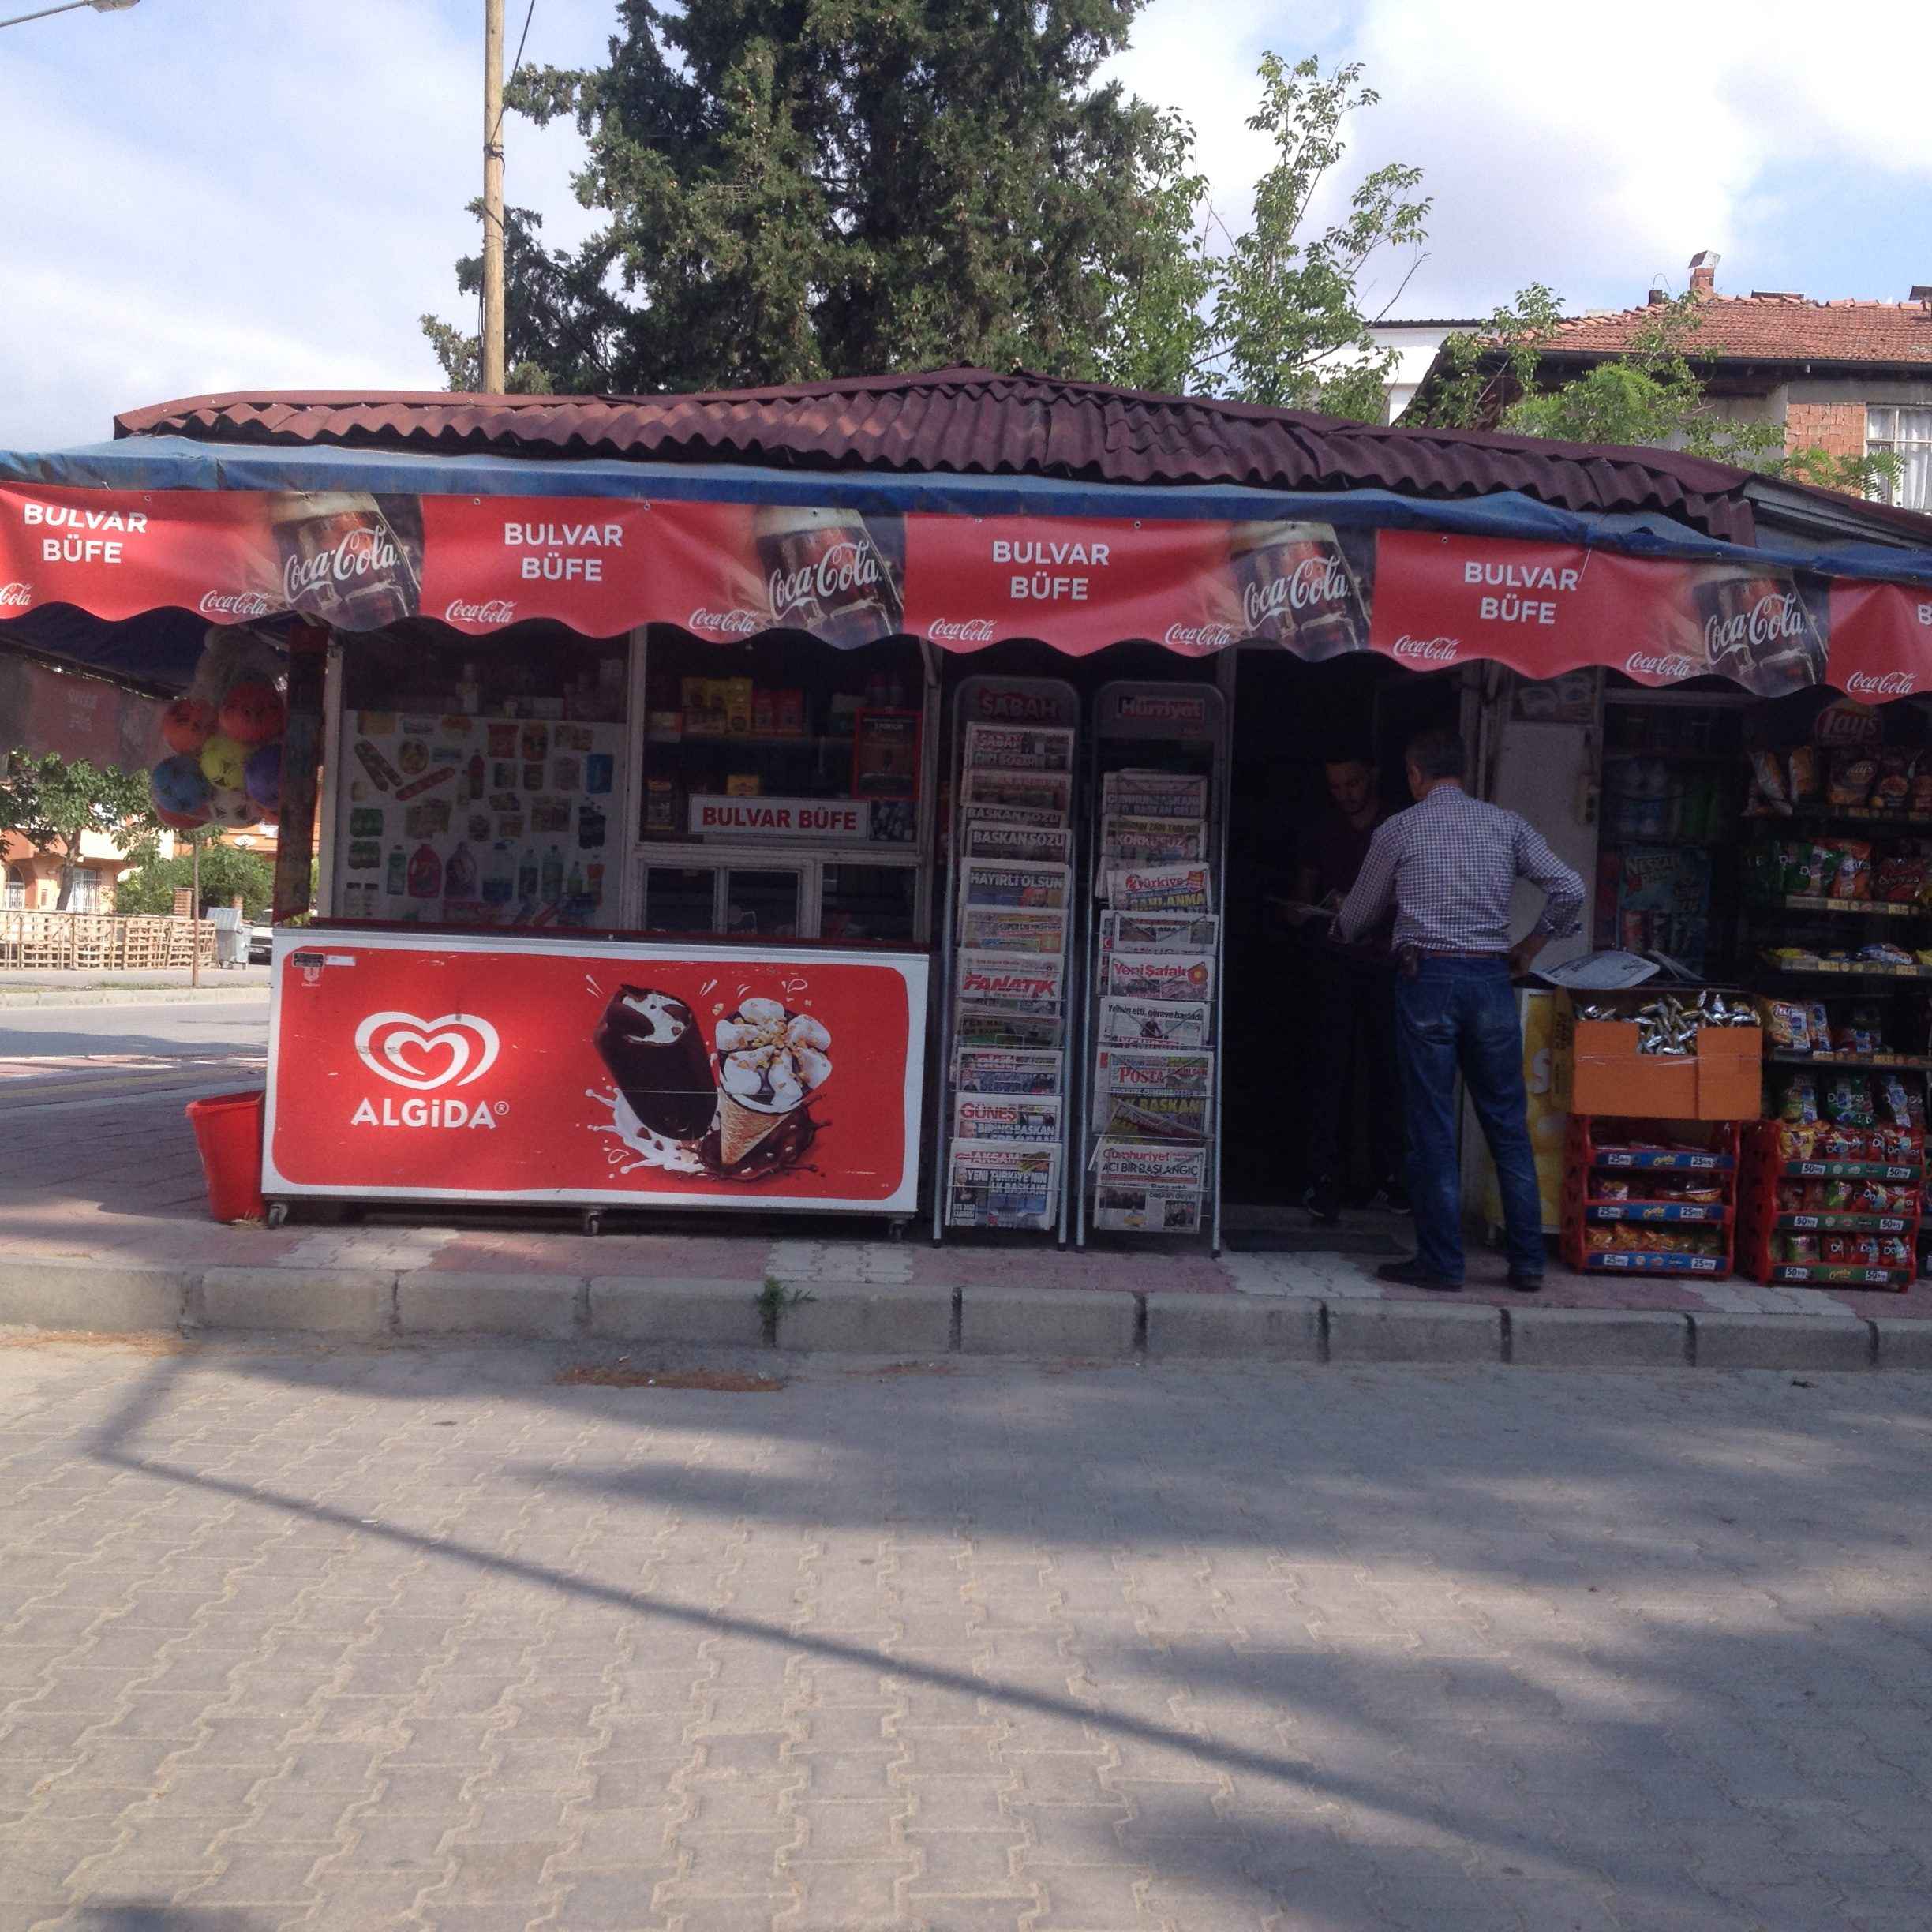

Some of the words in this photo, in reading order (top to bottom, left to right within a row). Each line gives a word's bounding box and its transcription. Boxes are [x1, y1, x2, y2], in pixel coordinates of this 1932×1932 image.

[24, 504, 148, 534] BULVAR
[504, 522, 623, 548] BULVAR
[43, 535, 124, 564] BÜFE
[993, 541, 1110, 567] BULVAR
[283, 524, 397, 603] Coca-Cola
[522, 552, 603, 582] BÜFE
[1465, 562, 1578, 591] BULVAR
[768, 540, 880, 620] Coca-Cola
[1010, 571, 1089, 601] BÜFE
[1243, 555, 1348, 630] Coca-Cola
[199, 590, 269, 616] Coca-Cola
[445, 599, 518, 624] Coca-Cola
[1480, 593, 1557, 625] BÜFE
[689, 608, 758, 634] Coca-Cola
[928, 619, 996, 642] Coca-Cola
[1704, 593, 1806, 667] Coca-Cola
[1165, 623, 1233, 646] Coca-Cola
[1393, 635, 1460, 661] Coca-Cola
[1626, 651, 1692, 677] Coca-Cola
[1847, 671, 1919, 695] Coca-Cola
[702, 806, 792, 829] BULVAR
[798, 806, 857, 830] BÜFE
[1103, 1148, 1169, 1163] Cumhuriyet
[1103, 1163, 1119, 1172] ACI
